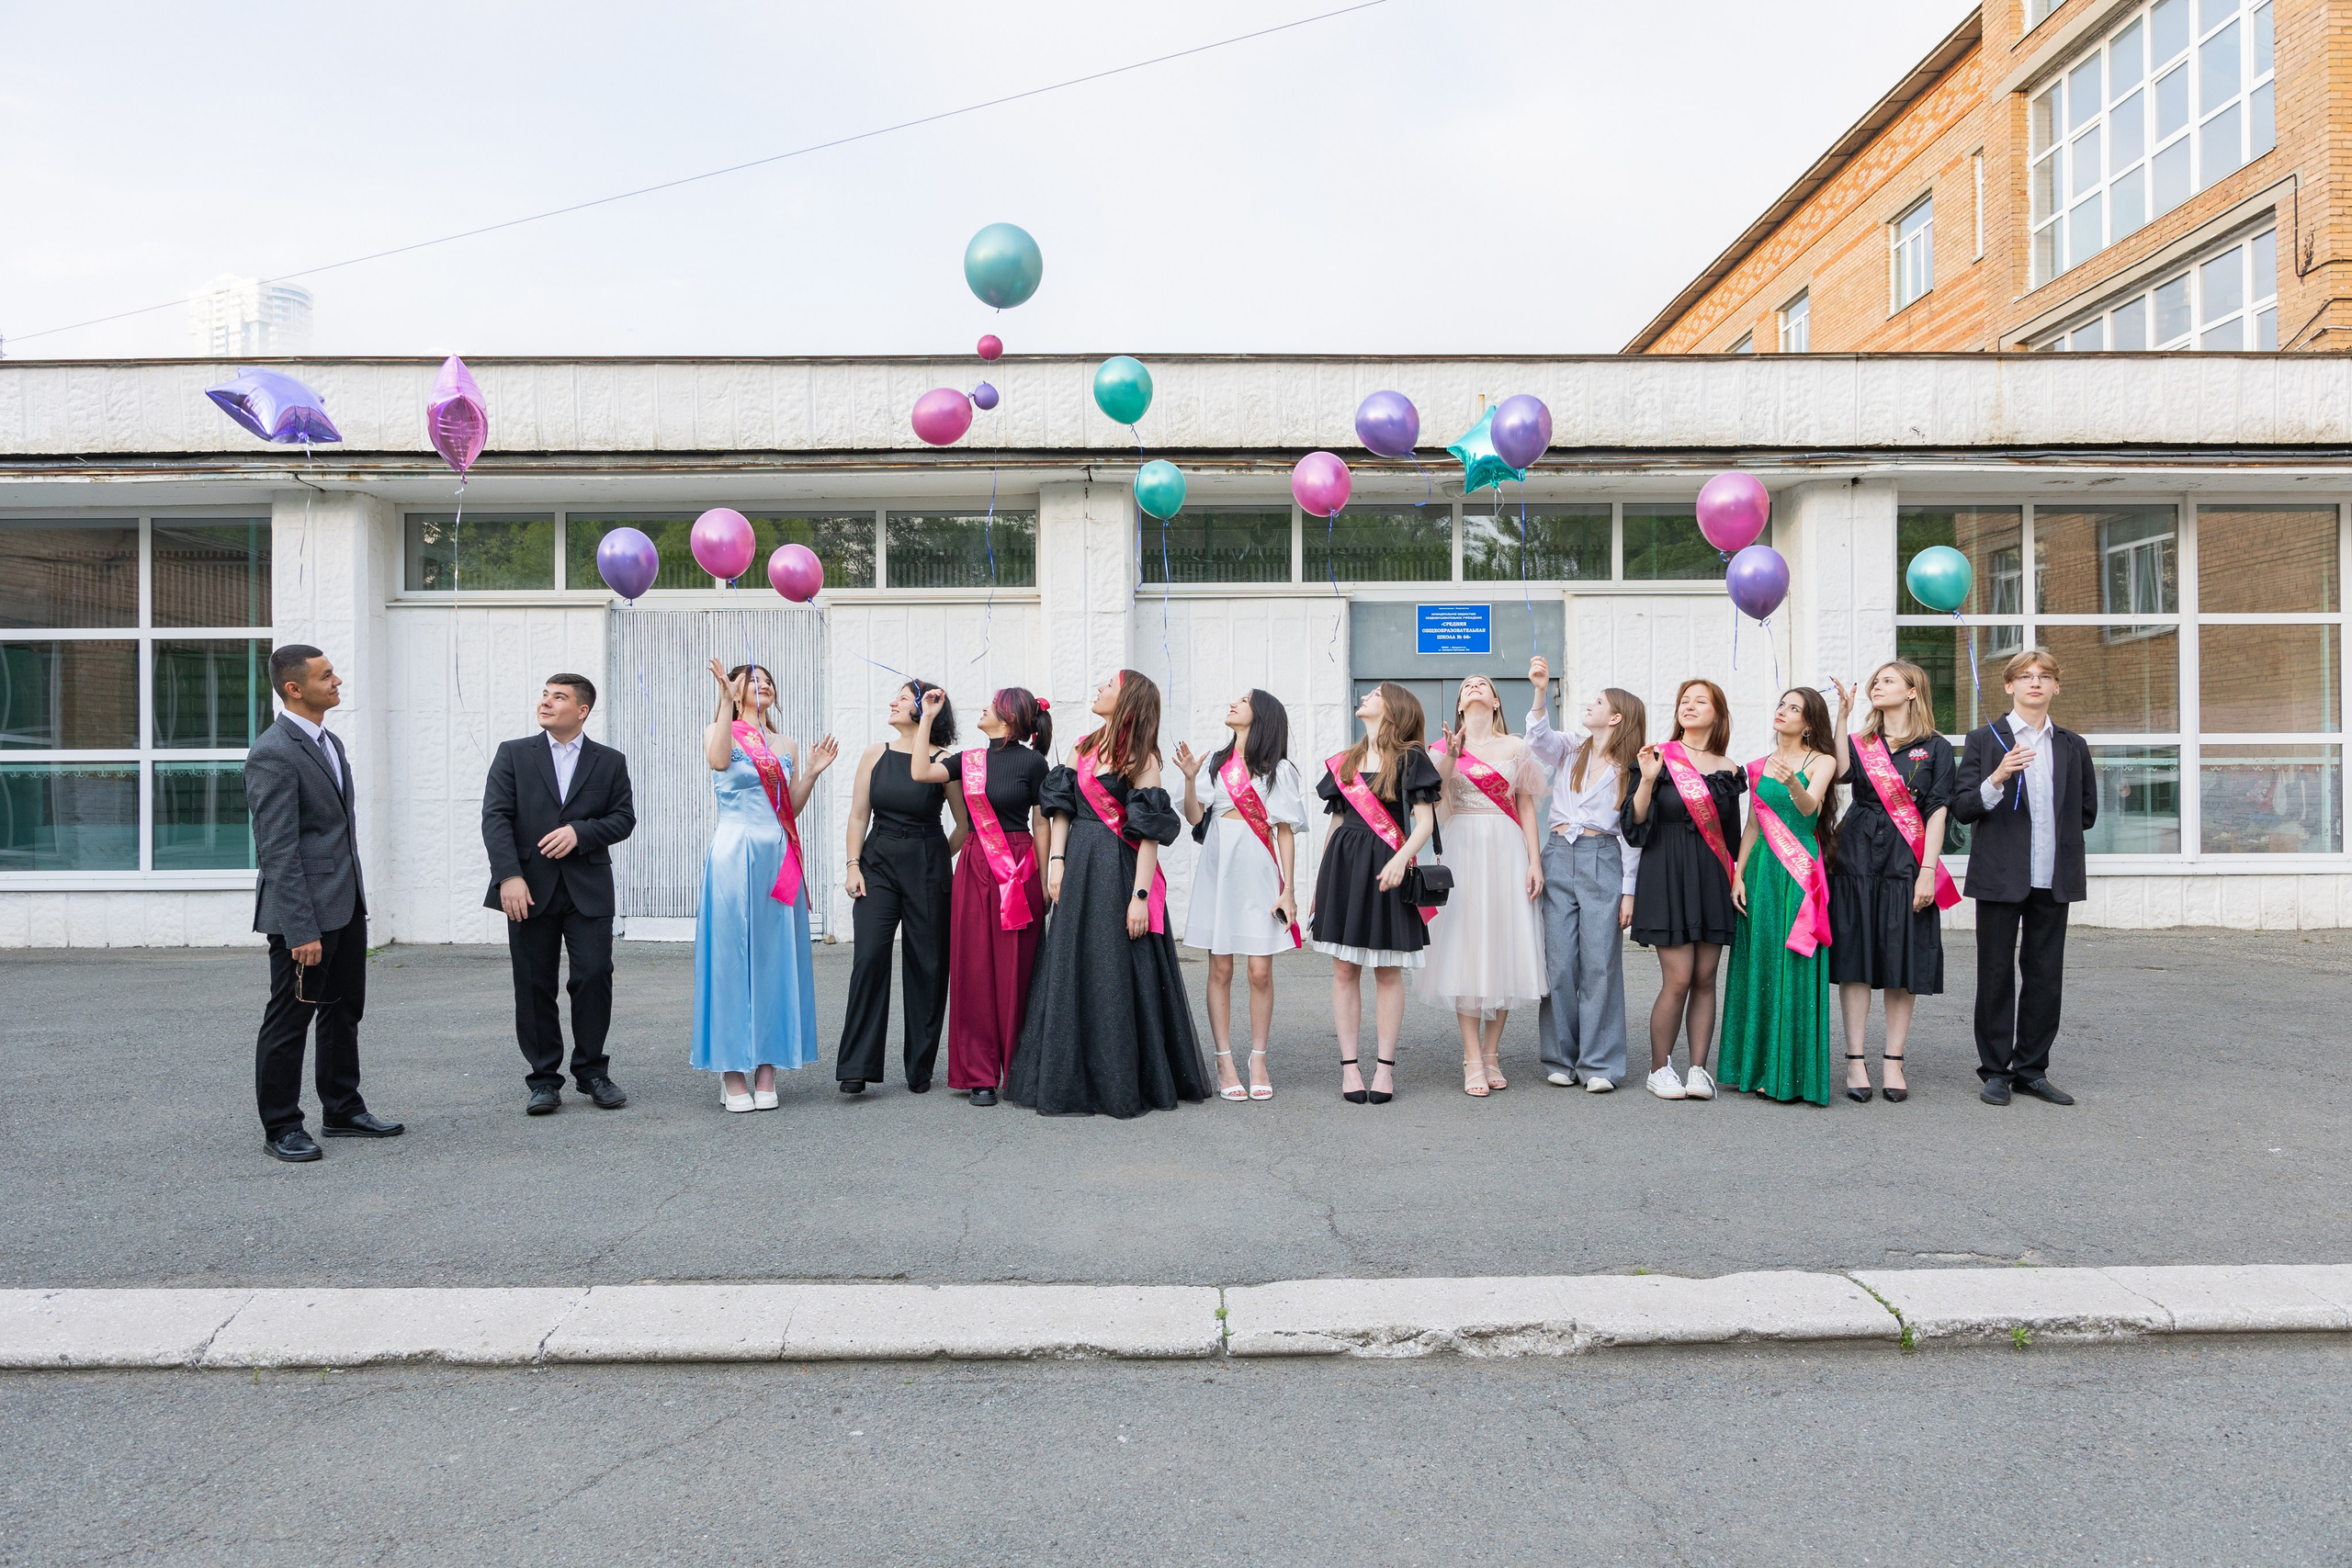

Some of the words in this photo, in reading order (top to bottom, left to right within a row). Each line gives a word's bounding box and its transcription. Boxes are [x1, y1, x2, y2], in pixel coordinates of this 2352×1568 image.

[1863, 751, 1909, 818] Выпускница
[1903, 816, 1924, 838] 2024
[1791, 852, 1815, 875] 2024
